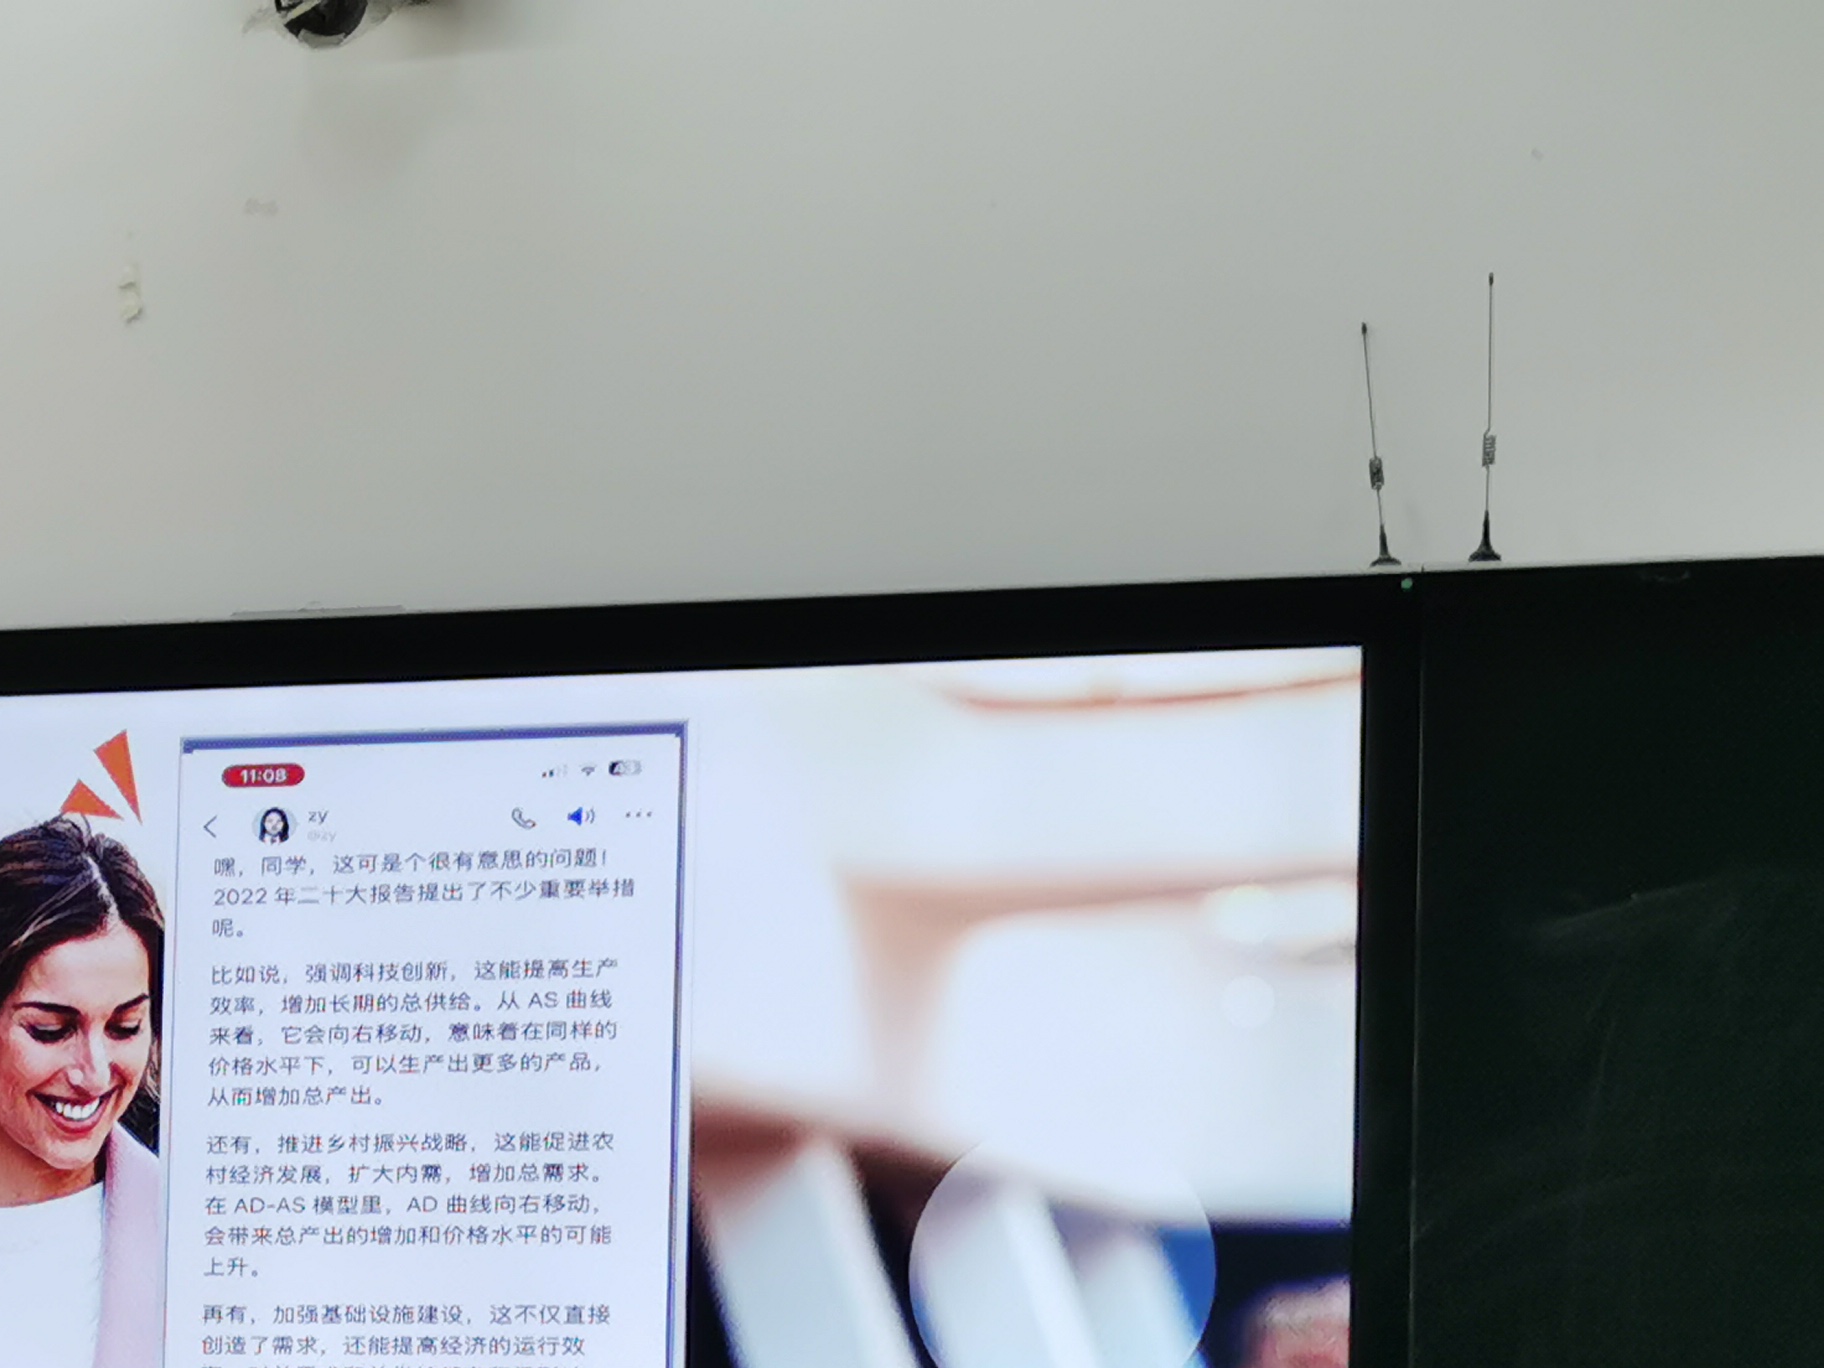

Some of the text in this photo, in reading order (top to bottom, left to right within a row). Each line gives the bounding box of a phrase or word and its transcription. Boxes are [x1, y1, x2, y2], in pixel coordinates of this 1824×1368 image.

[240, 766, 287, 785] 11:08
[308, 810, 329, 826] zy
[214, 887, 268, 907] 2022
[211, 917, 245, 938] 呢。
[527, 991, 559, 1009] AS
[565, 989, 613, 1010] 曲线
[207, 1085, 383, 1107] 从而增加总产出。
[204, 1195, 227, 1216] 在
[233, 1196, 306, 1214] AD-AS
[204, 1224, 612, 1247] 会带来总产出的增加和价格水平的可能
[203, 1256, 259, 1278] 上升。
[201, 1335, 585, 1356] 创造了需求，还能提高经济的运行效
